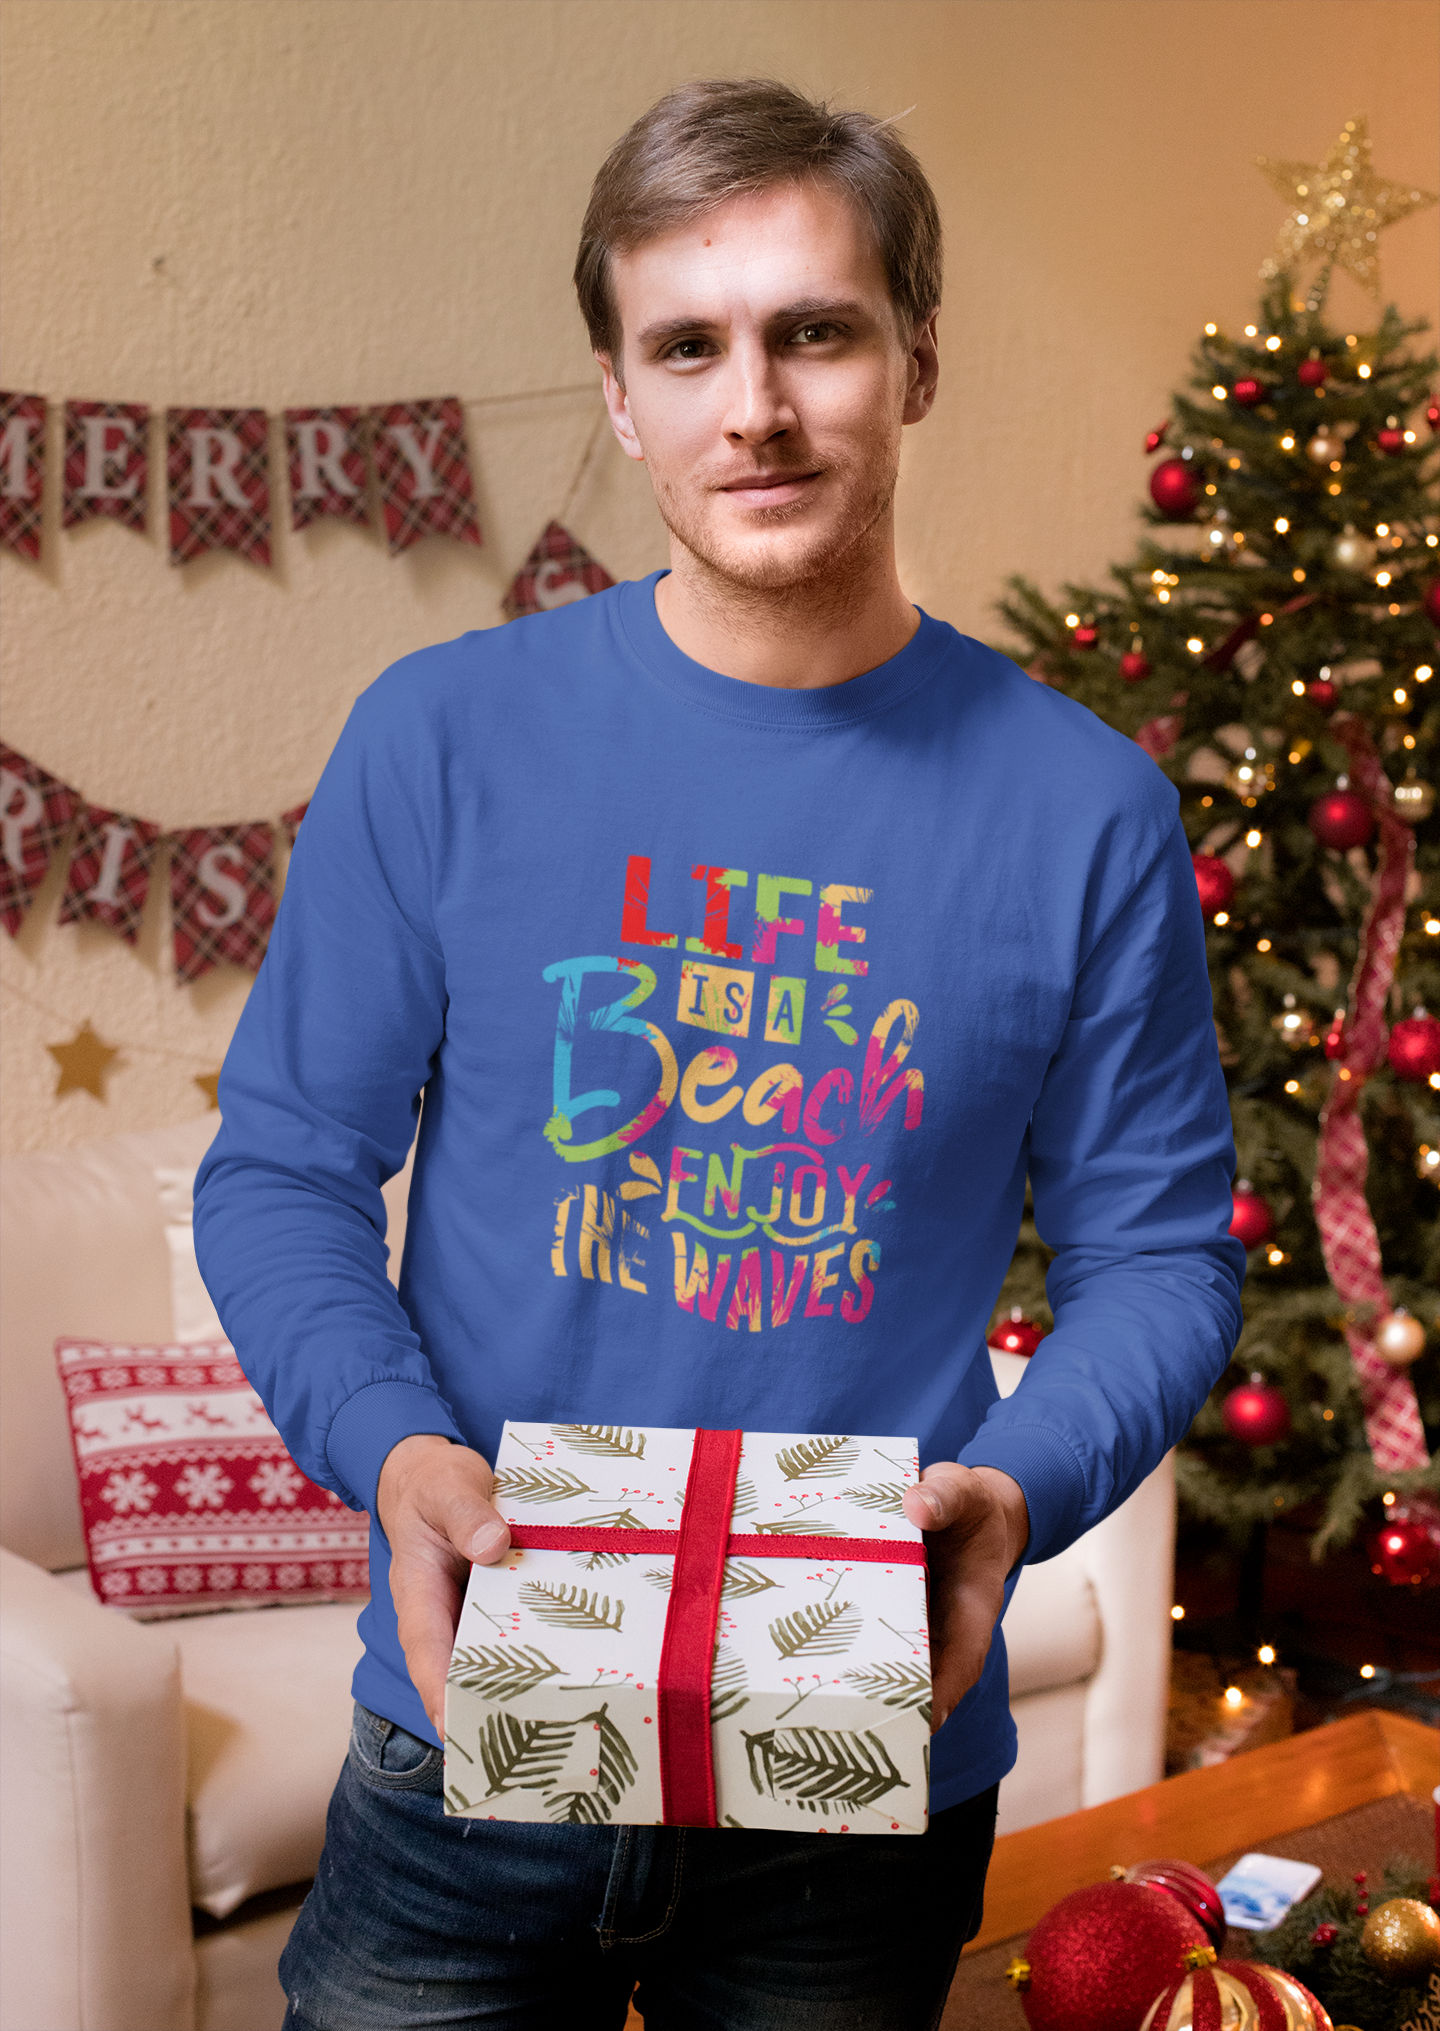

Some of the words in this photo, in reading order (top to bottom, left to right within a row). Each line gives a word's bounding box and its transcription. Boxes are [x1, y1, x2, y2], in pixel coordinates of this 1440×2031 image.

[620, 854, 875, 977] LIFE
[542, 955, 925, 1163] Beach
[686, 972, 747, 1026] IS
[769, 986, 798, 1036] A
[660, 1142, 873, 1246] ENJOY
[550, 1183, 650, 1295] THE
[671, 1238, 882, 1333] WAVES
